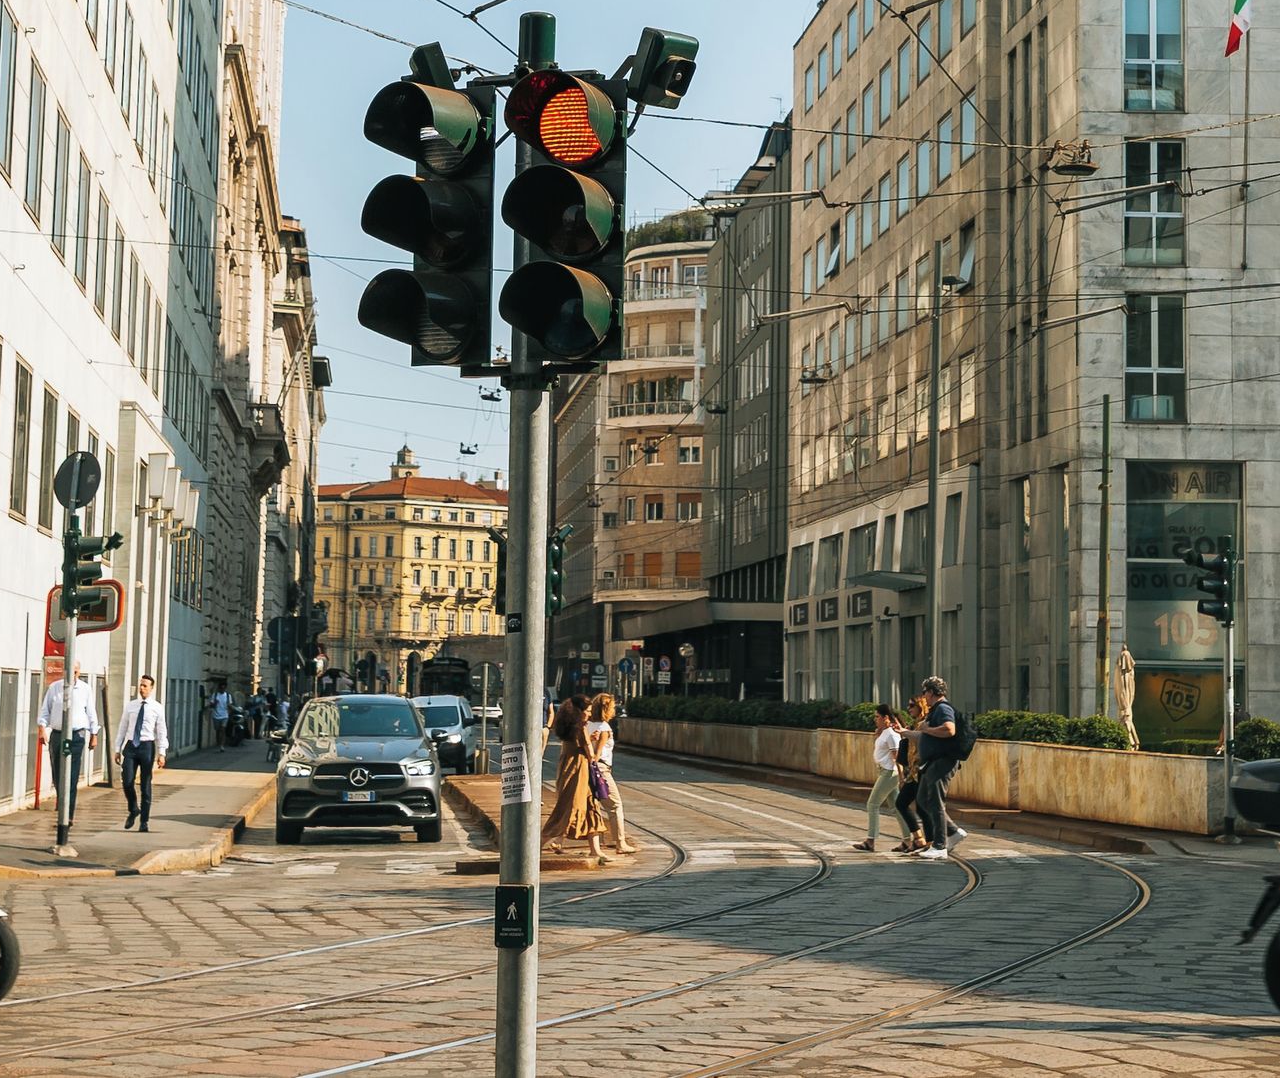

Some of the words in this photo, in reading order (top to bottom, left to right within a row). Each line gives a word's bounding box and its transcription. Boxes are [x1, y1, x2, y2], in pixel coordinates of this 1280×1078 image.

[1184, 471, 1232, 494] AIR
[1153, 611, 1218, 647] 105
[1165, 689, 1195, 710] 105
